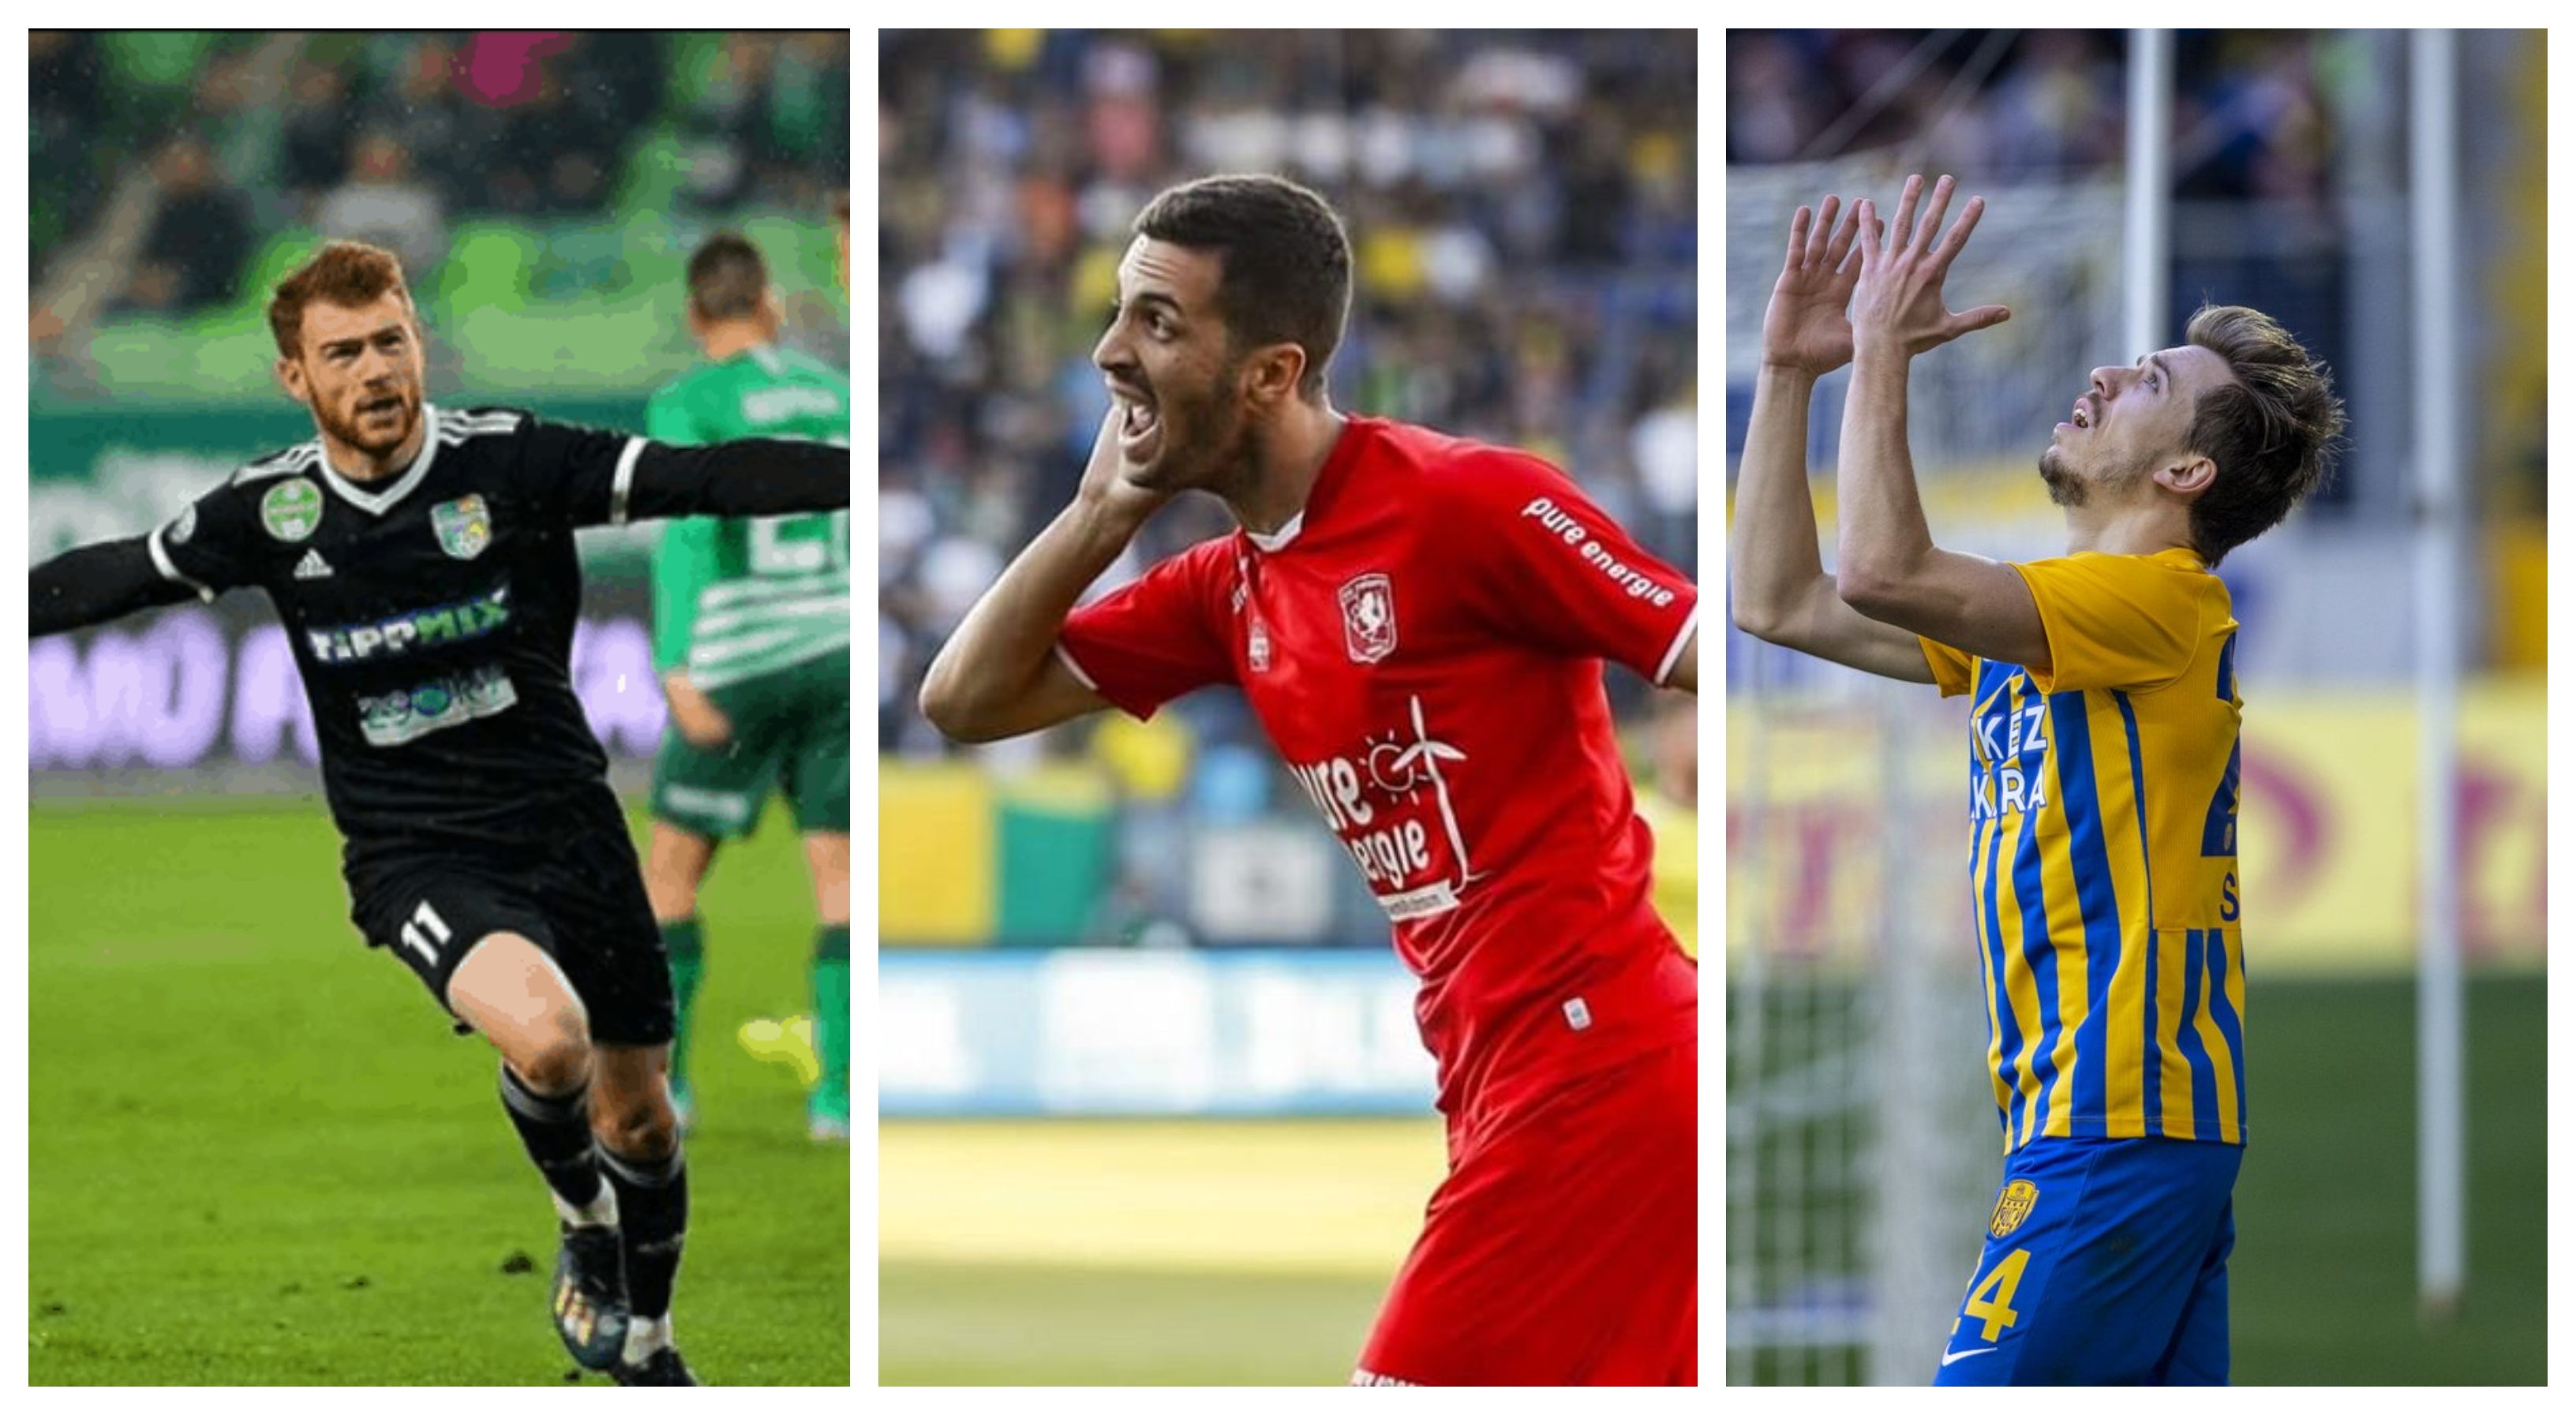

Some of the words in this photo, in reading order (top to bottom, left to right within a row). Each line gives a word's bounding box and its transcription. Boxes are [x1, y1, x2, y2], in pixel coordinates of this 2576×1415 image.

[1522, 498, 1586, 545] pure
[1581, 541, 1675, 607] energie
[1971, 705, 2048, 760] KEZ
[1288, 758, 1373, 831] ure
[1971, 763, 2047, 819] KRA
[1343, 819, 1429, 890] ergie
[401, 900, 452, 968] 11
[1951, 1247, 2031, 1343] 4
